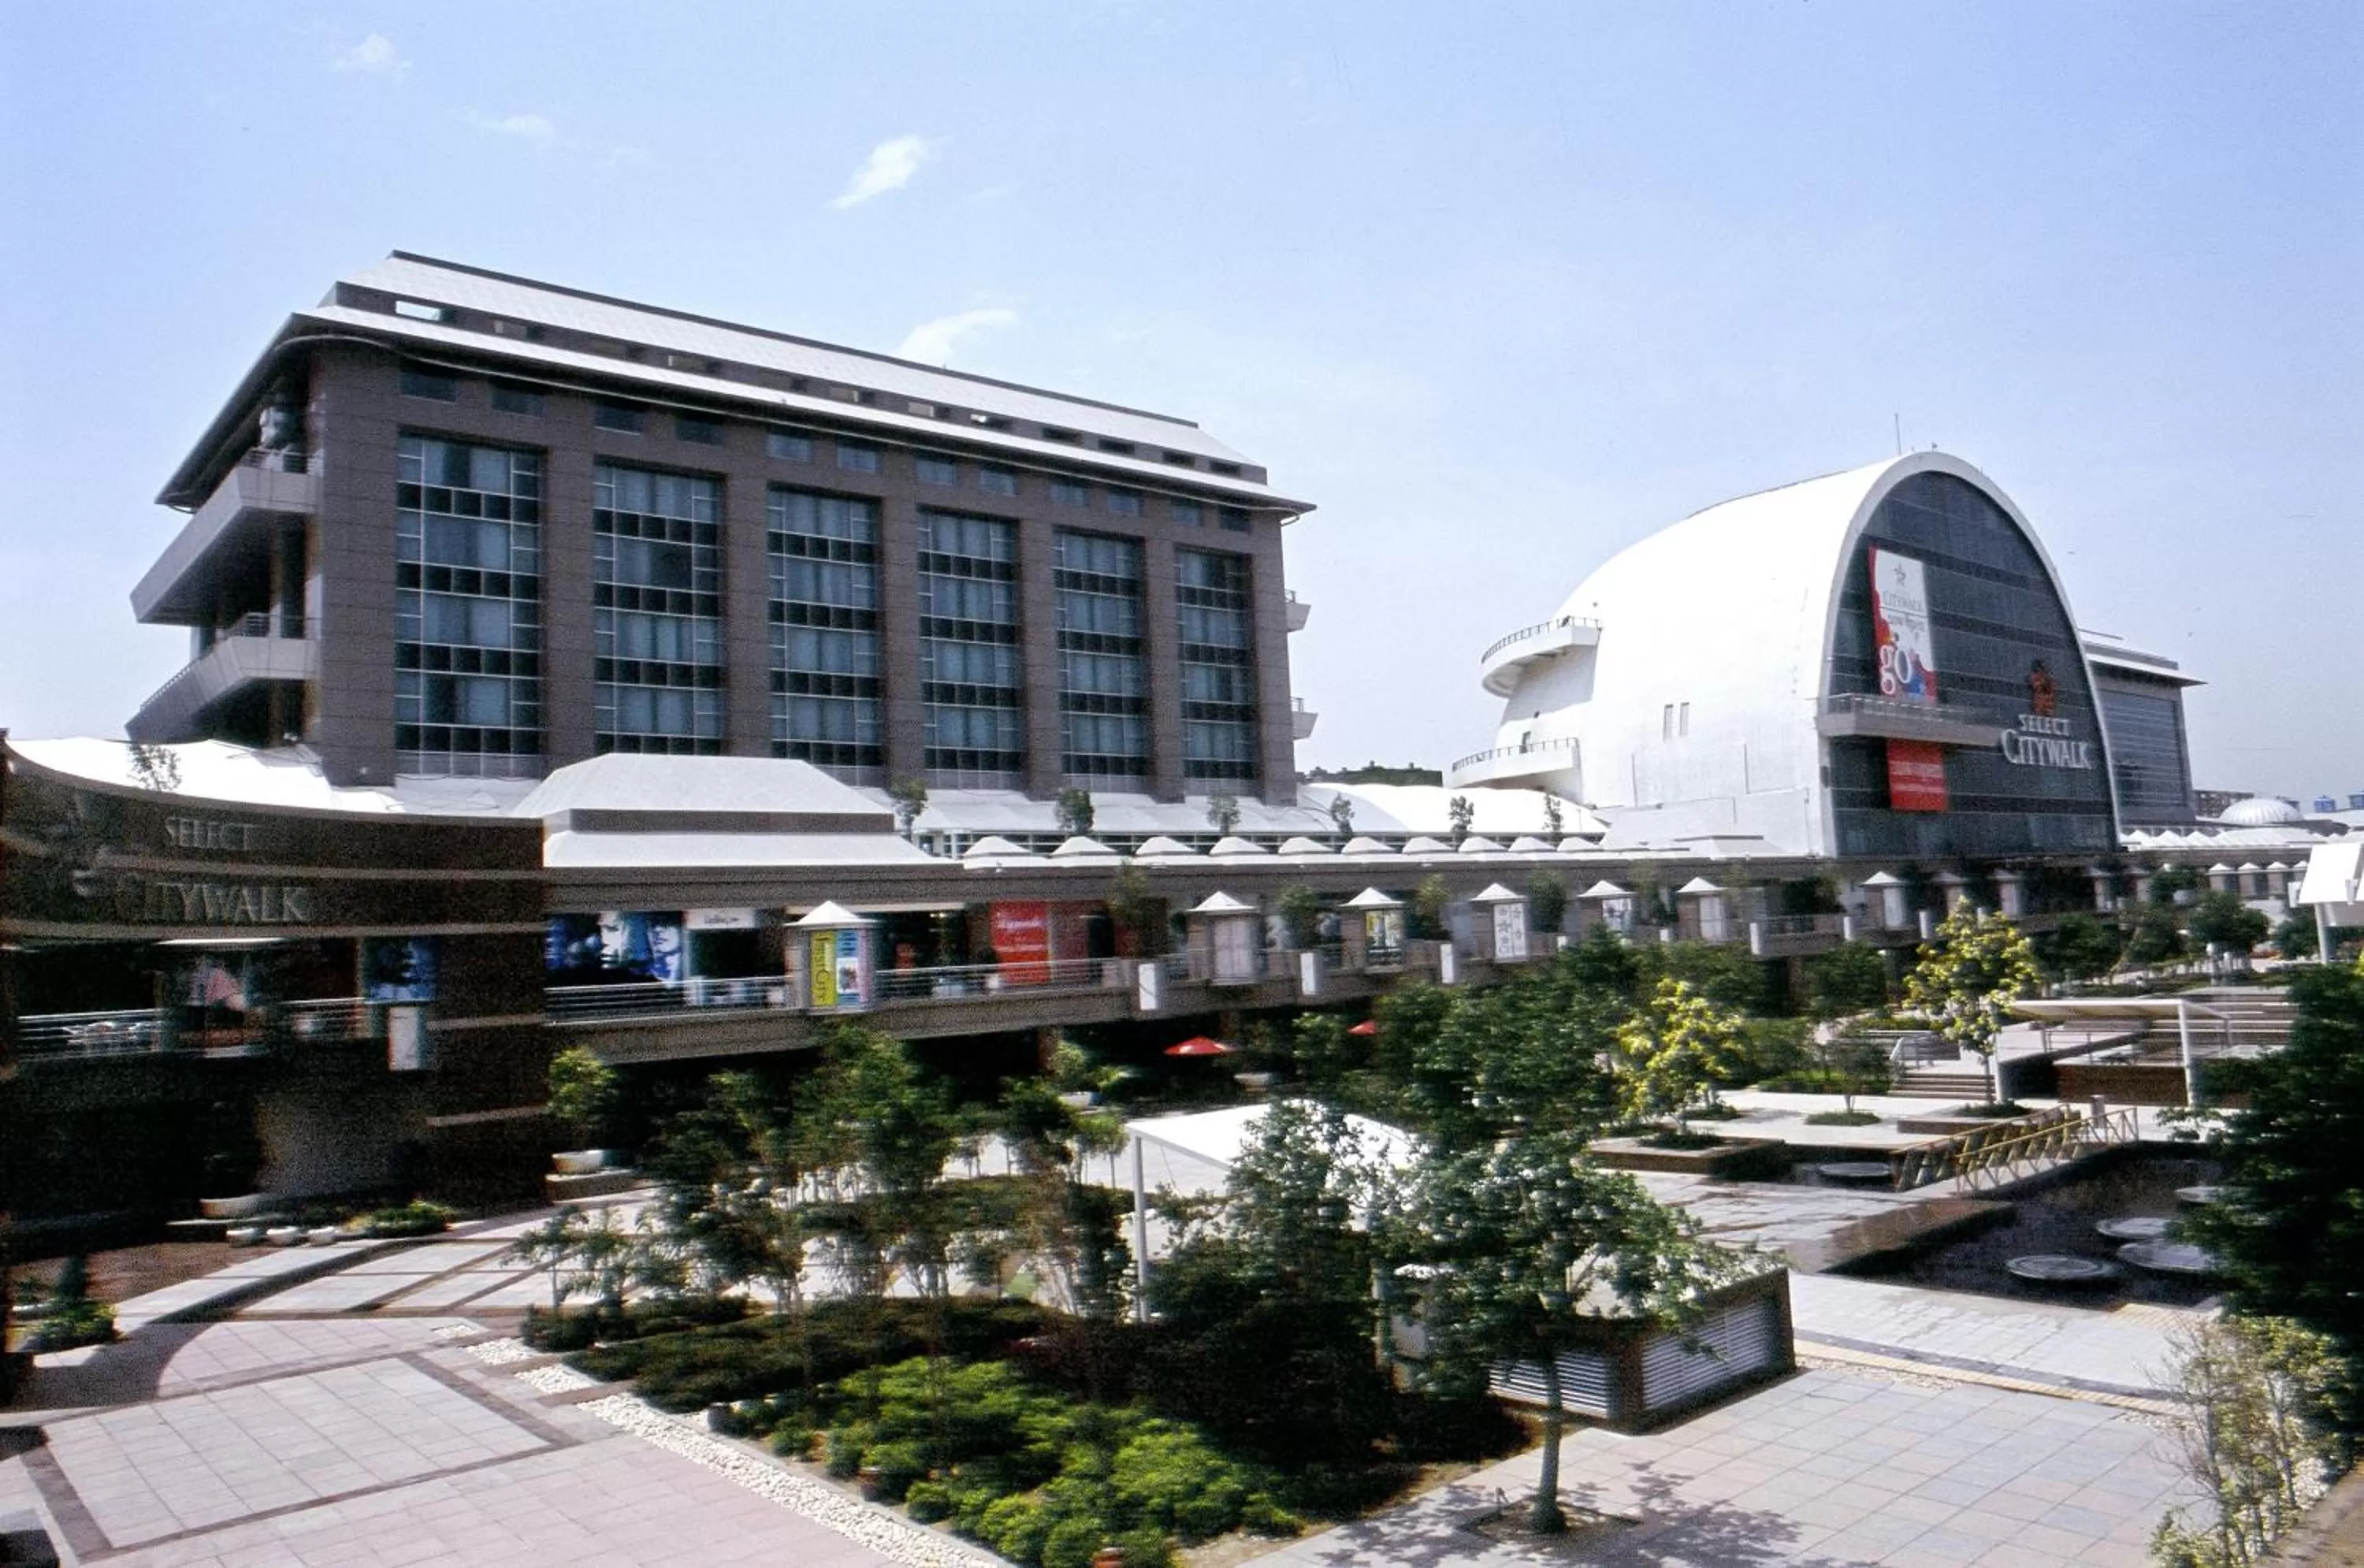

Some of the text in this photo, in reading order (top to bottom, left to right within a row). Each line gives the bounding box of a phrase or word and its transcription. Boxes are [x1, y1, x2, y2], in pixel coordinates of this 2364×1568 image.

[2018, 714, 2070, 737] SELECT
[2002, 729, 2093, 769] CITYWALK
[165, 816, 257, 850] SELECT
